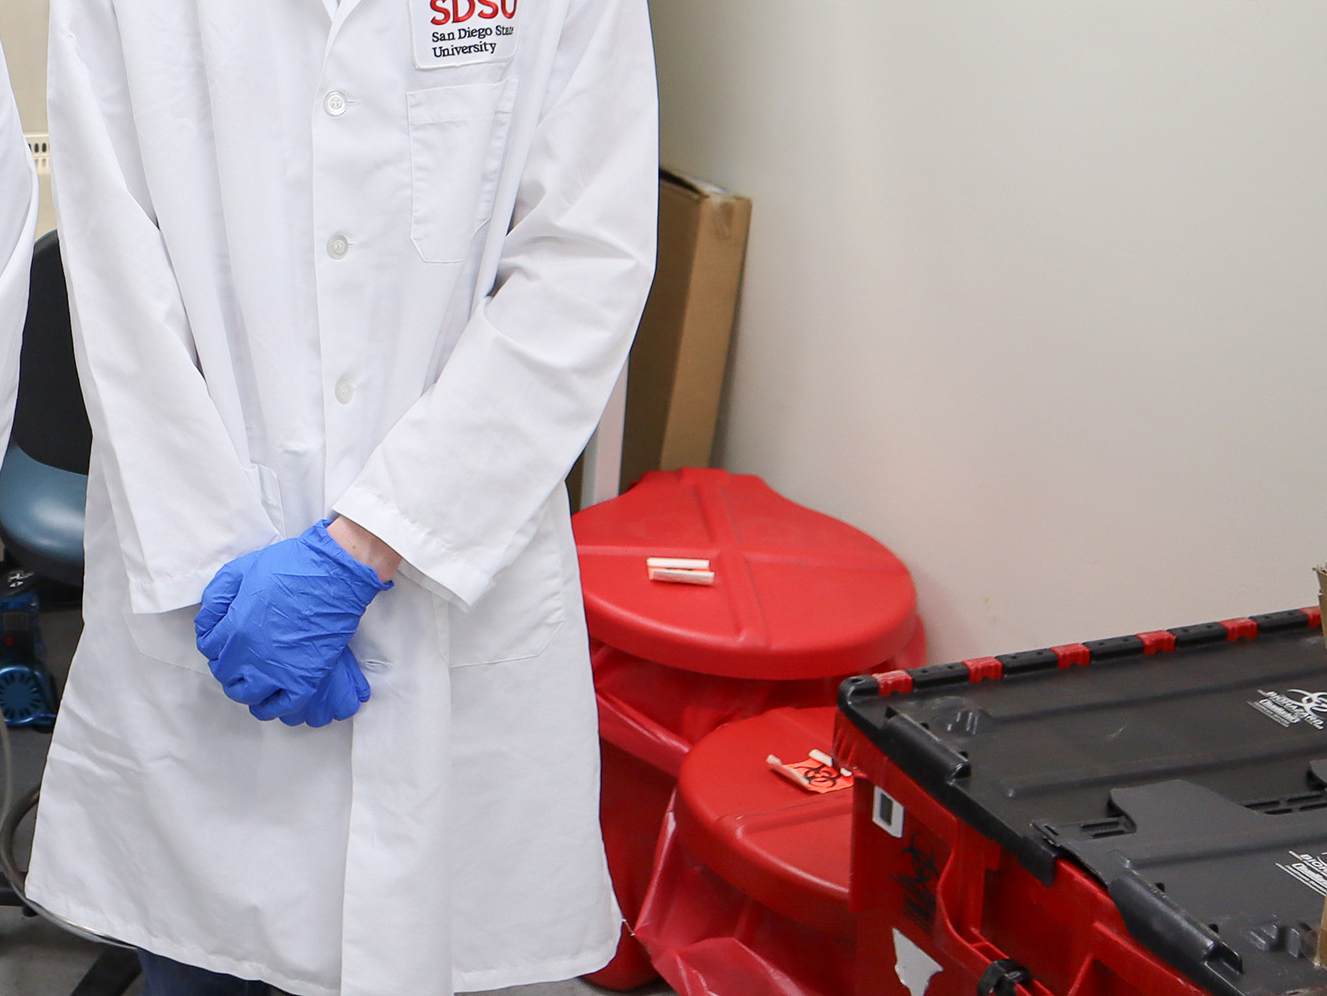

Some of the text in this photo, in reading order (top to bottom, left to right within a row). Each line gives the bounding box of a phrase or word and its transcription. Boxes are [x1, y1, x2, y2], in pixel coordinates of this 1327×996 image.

[432, 31, 455, 42] San
[458, 27, 492, 39] Diego
[432, 41, 497, 58] University
